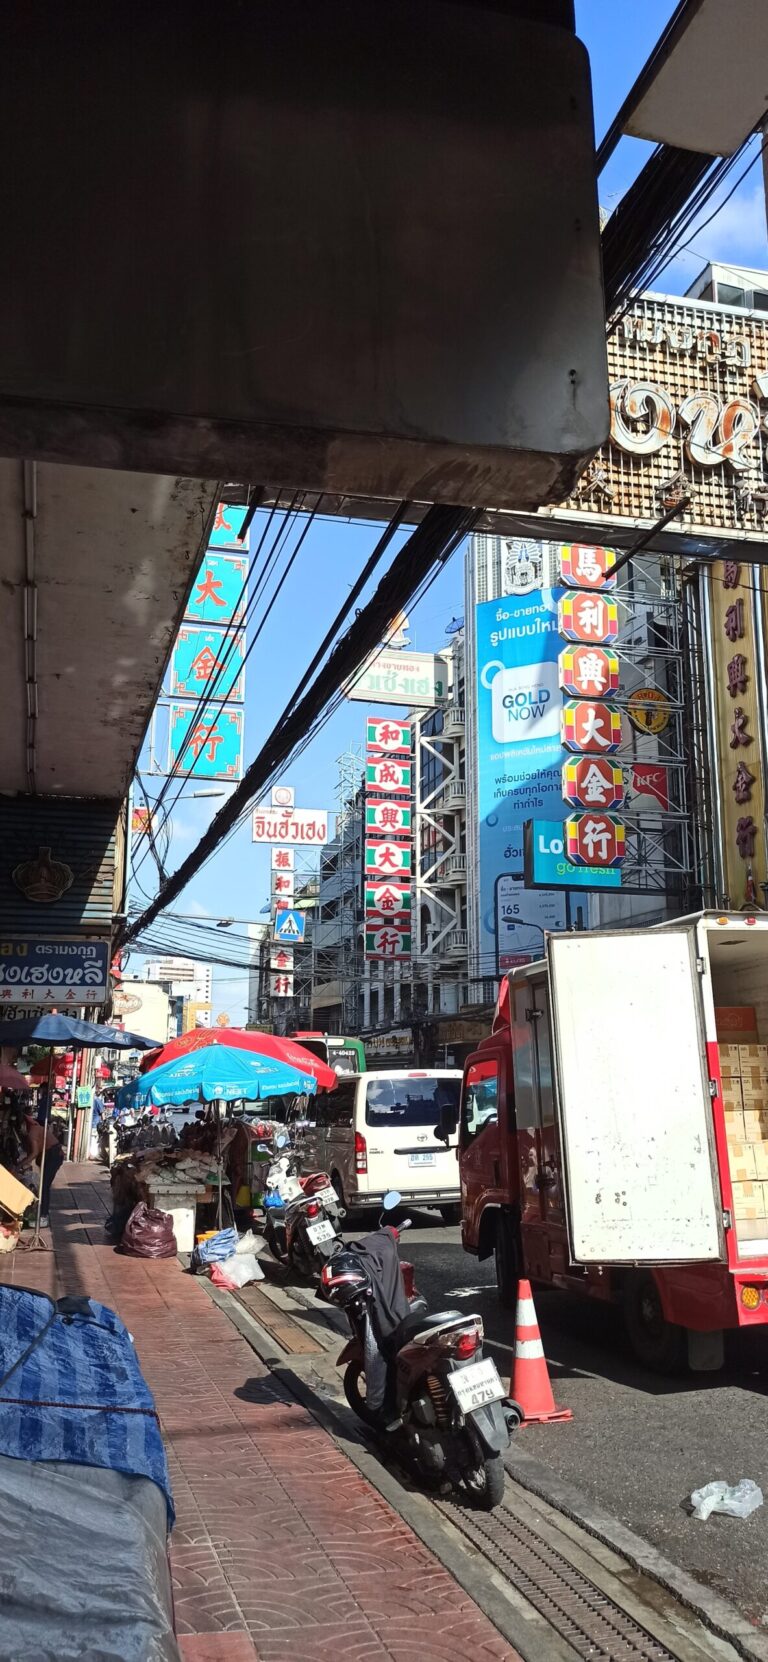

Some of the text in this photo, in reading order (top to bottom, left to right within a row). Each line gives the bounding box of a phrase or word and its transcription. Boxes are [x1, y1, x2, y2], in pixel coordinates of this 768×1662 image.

[502, 689, 551, 709] GOLD
[508, 704, 545, 722] NOW
[636, 772, 661, 787] KFC
[376, 724, 401, 956] 和成興大金行
[538, 835, 564, 854] Lo
[501, 904, 520, 915] 165
[471, 1388, 495, 1405] 479
